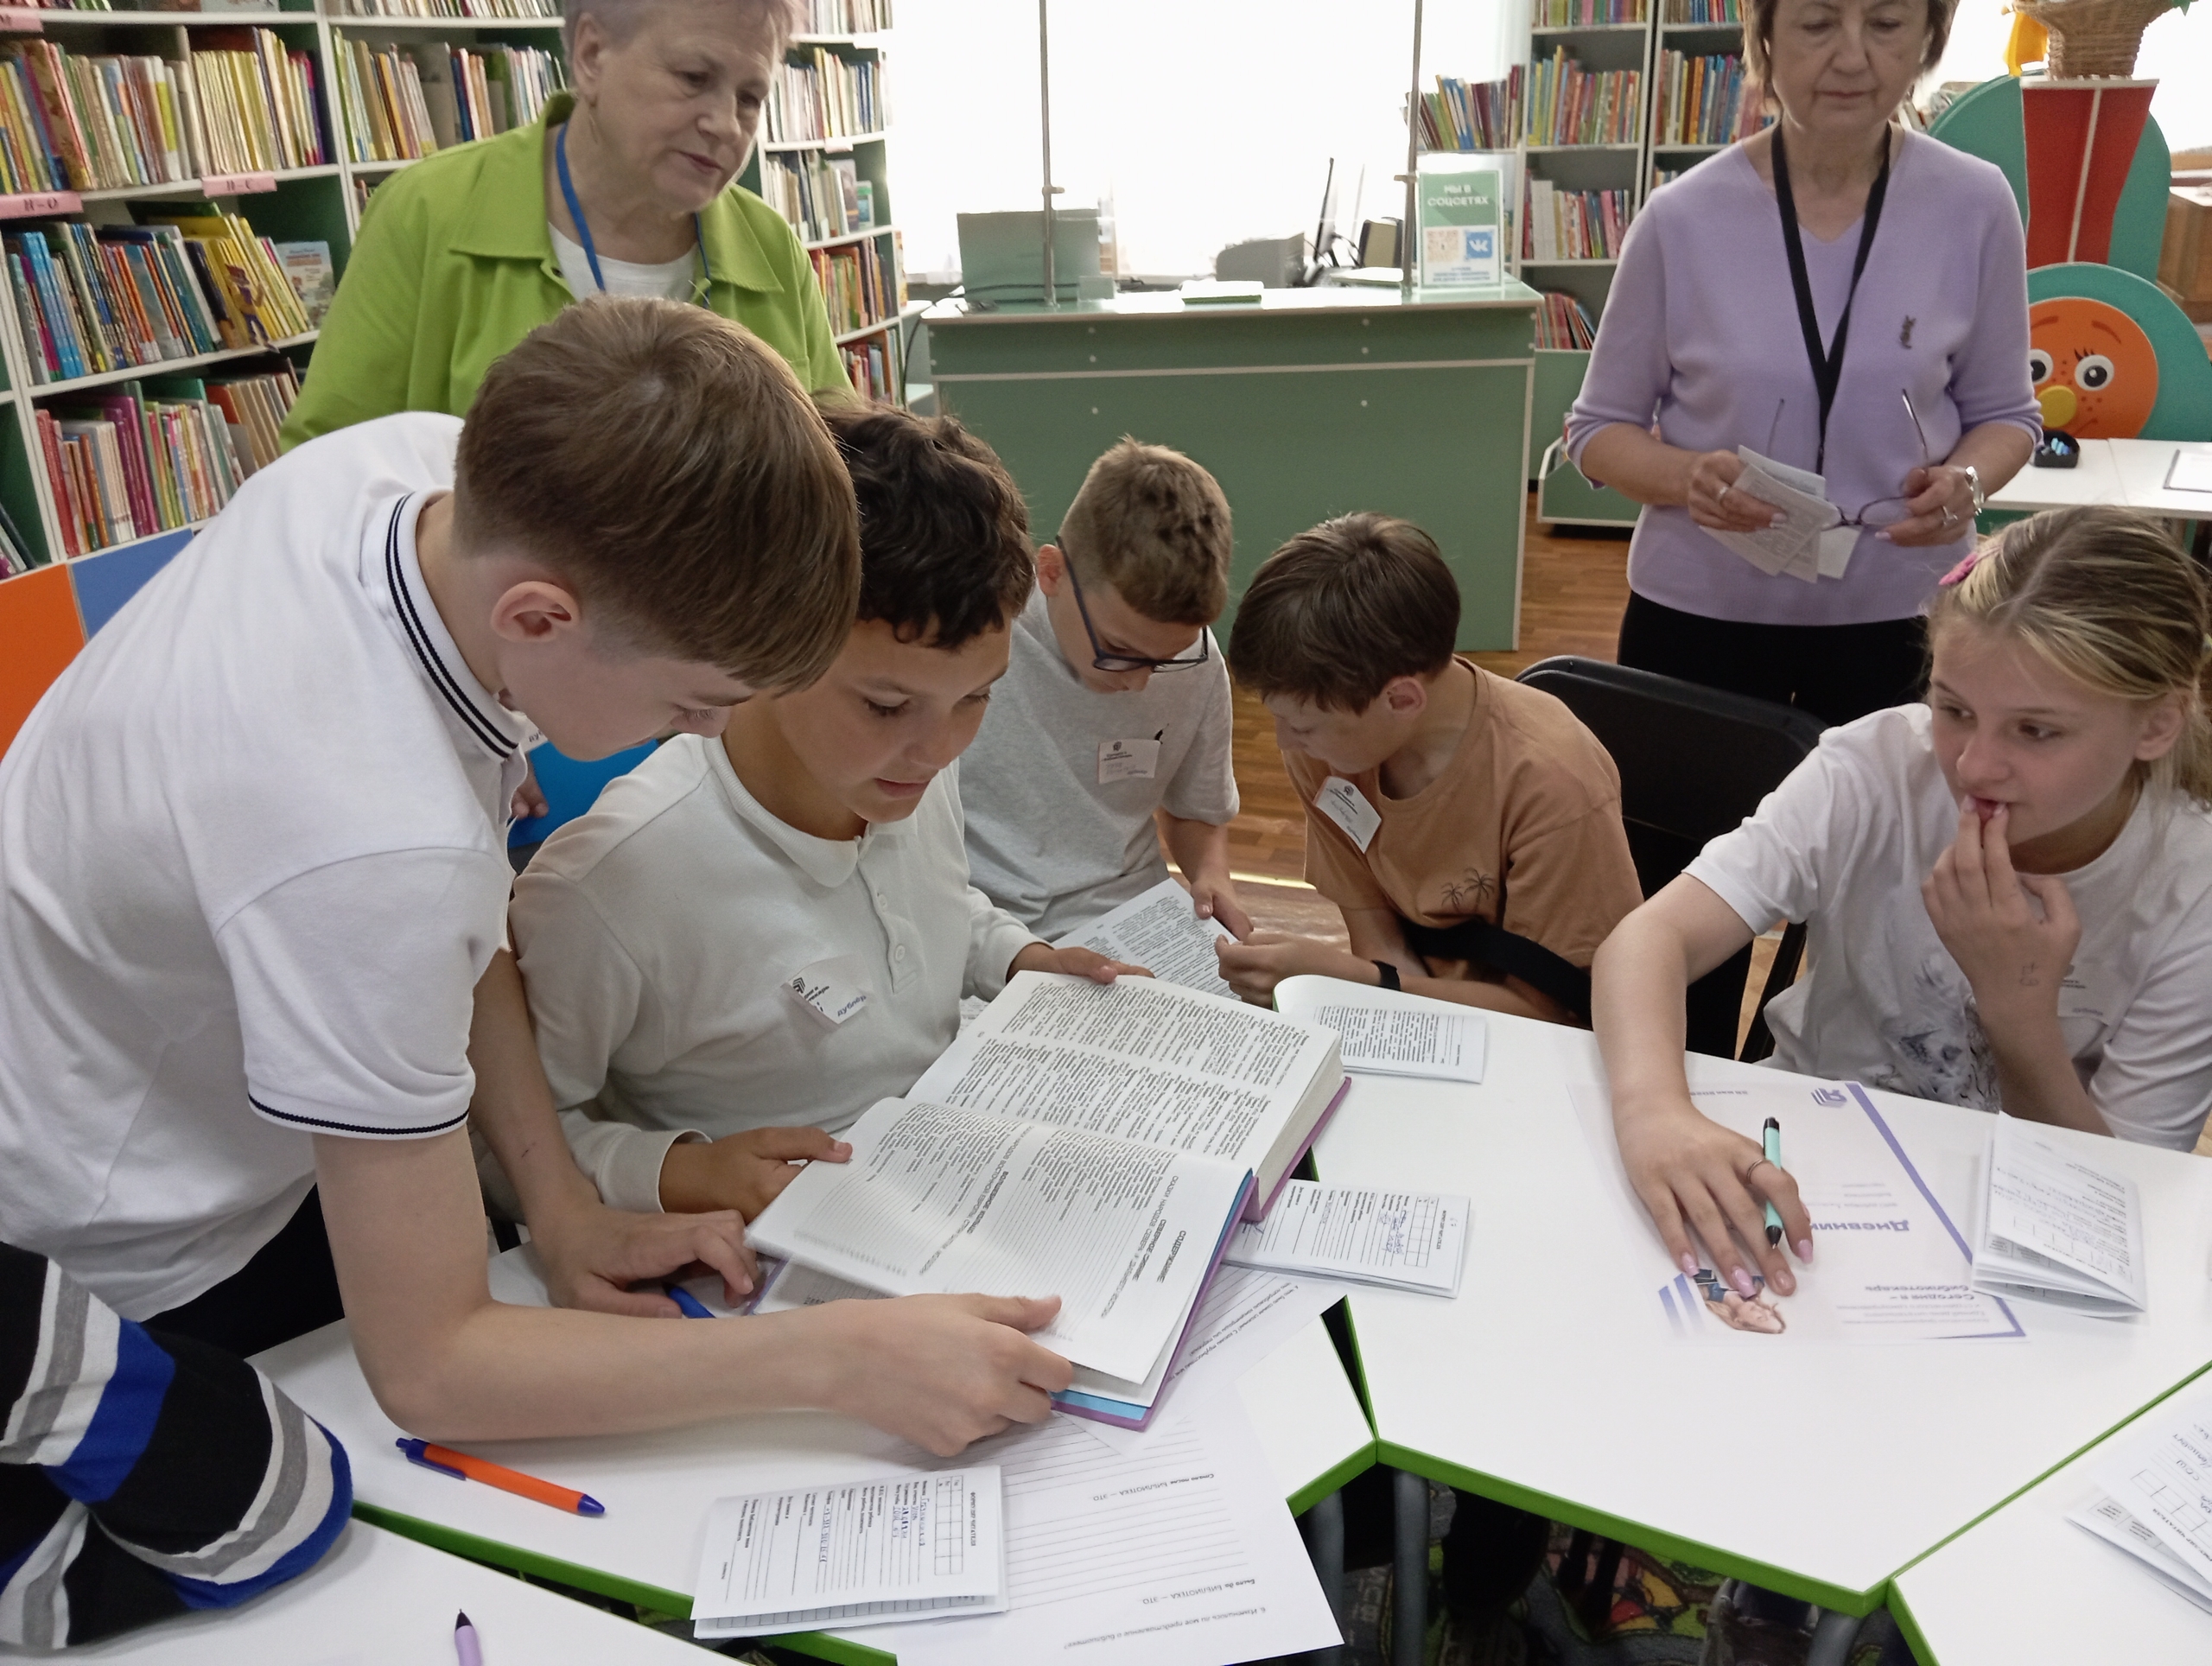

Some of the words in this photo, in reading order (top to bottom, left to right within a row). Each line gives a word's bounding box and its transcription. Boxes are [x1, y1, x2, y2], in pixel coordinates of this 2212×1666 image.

[1444, 184, 1461, 194] МЫ
[1462, 184, 1471, 194] В
[1427, 195, 1489, 207] СОЦСЕТЯХ
[1118, 1481, 1167, 1496] БИБЛИОТЕКА
[1170, 1584, 1222, 1599] БИБЛИОТЕКА
[1122, 1619, 1183, 1637] представление
